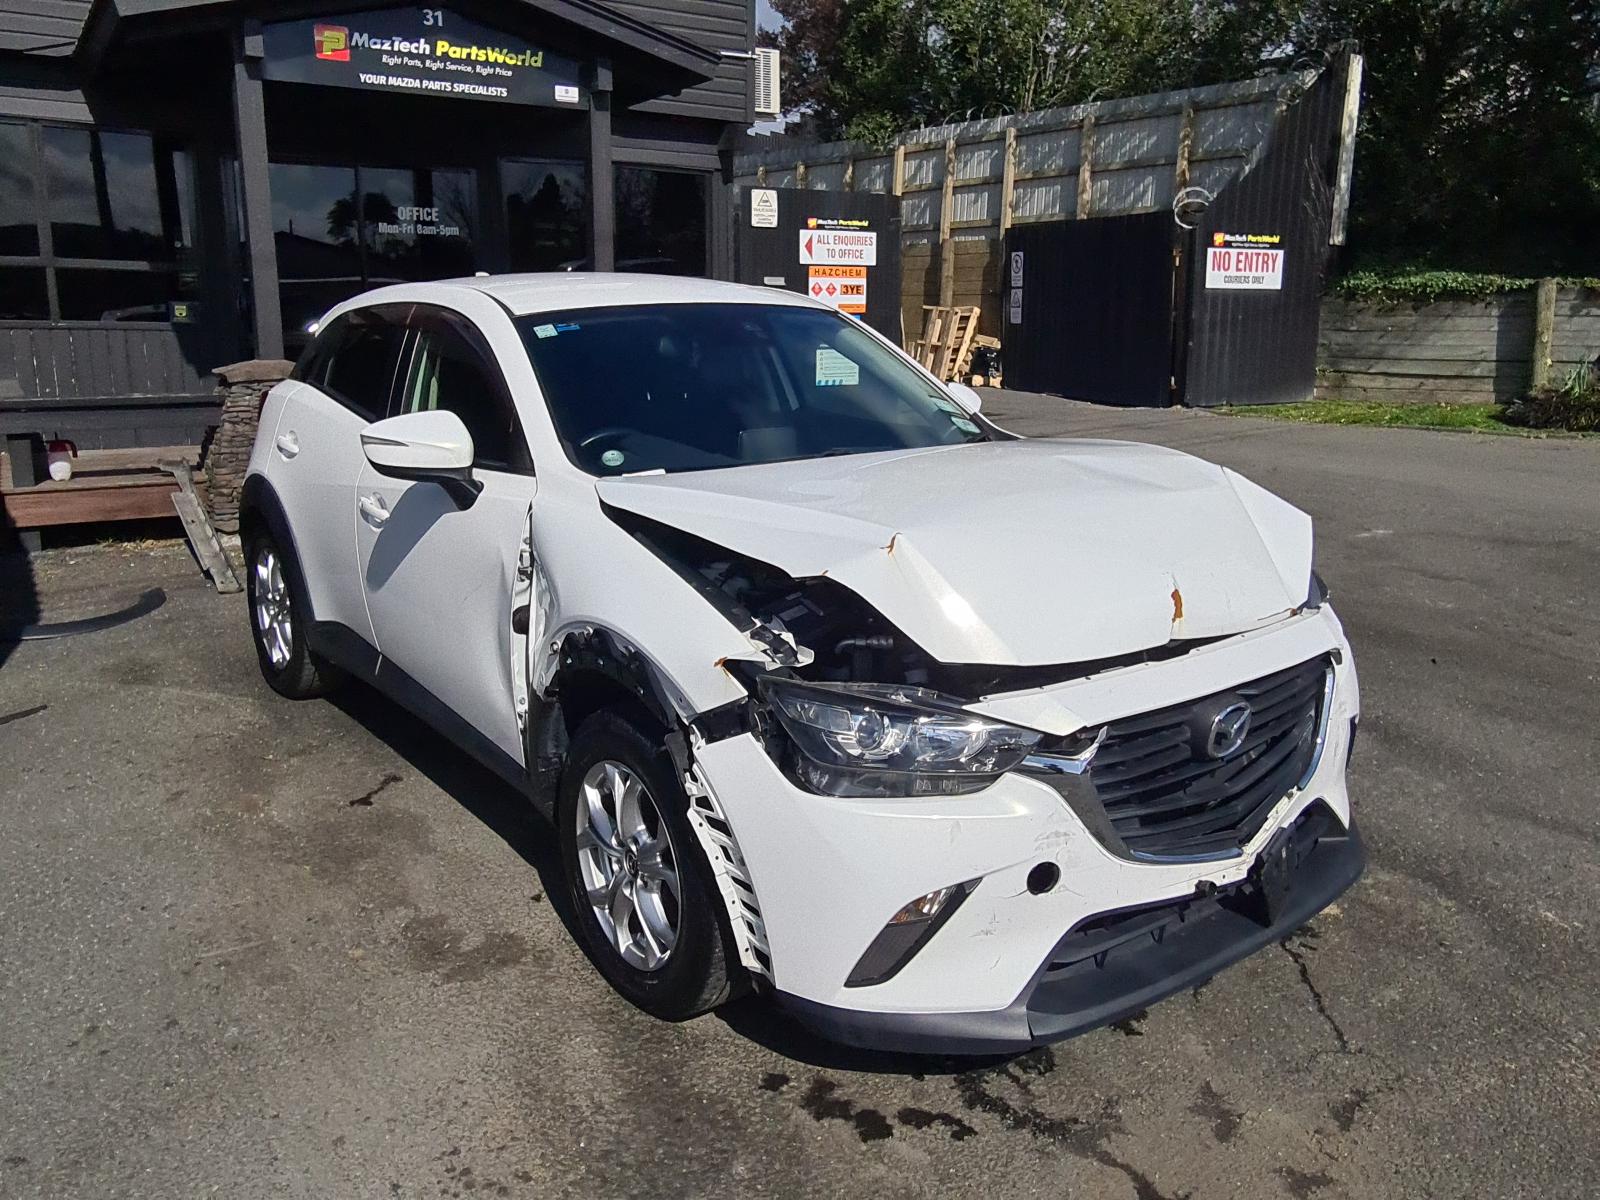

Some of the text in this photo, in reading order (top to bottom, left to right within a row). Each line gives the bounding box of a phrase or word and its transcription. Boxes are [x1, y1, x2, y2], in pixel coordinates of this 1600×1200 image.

[423, 9, 443, 26] 31
[351, 32, 430, 55] MazTech
[436, 40, 543, 67] PartsWorld
[382, 54, 512, 77] Right Parts, Right Service, Right Price
[359, 73, 508, 97] YOUR MAZDA PARTS SPECIALISTS
[397, 206, 439, 221] OFFICE
[378, 222, 459, 237] Mon-Fri 8am-5pm
[816, 234, 873, 247] ALL ENQUIRIES
[826, 248, 864, 260] TO OFFICE
[1212, 250, 1279, 273] NO ENTRY
[814, 268, 862, 277] HAZCHEM
[842, 284, 862, 295] 3YE
